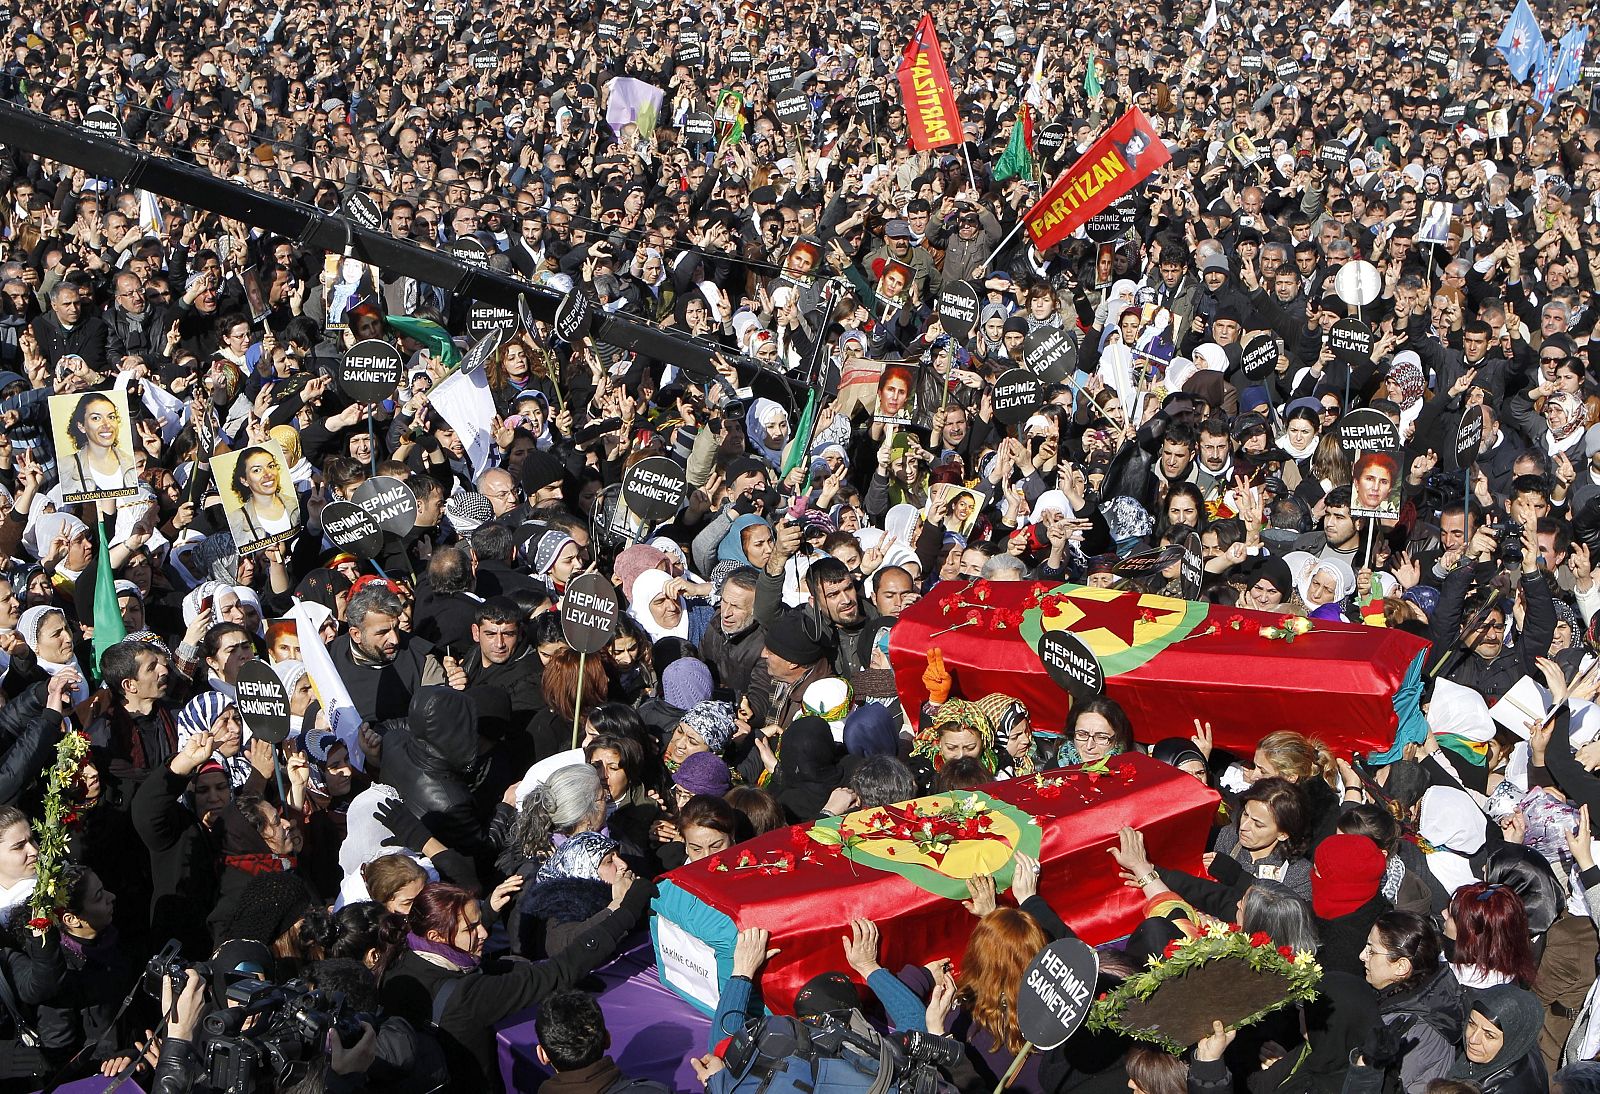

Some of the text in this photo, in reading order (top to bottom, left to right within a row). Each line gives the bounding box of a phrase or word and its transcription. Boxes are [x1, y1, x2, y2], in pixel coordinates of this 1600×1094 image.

[768, 66, 790, 76] HEPİMİZ
[776, 96, 806, 109] HEPİMİZ
[857, 90, 880, 100] HEPİMİZ
[777, 103, 808, 117] FİDAN'IZ
[83, 119, 117, 130] HEPİMİZ
[687, 119, 712, 128] HEPİMİZ
[1042, 131, 1064, 140] HEPİMİZ
[1323, 145, 1347, 156] HEPİMİZ
[1030, 151, 1125, 238] PARTİZAN
[351, 194, 379, 225] HEPİMİZ
[453, 249, 485, 261] HEPİMİZ
[559, 289, 584, 329] HEPİMİZ
[942, 292, 975, 310] HEPİMİZ
[471, 319, 514, 329] LEYLA'YIZ
[564, 295, 590, 338] FİDAN'IZ
[940, 307, 974, 323] SAKİNE'YİZ
[1332, 328, 1370, 343] HEPİMİZ
[1026, 331, 1064, 365] HEPİMİZ
[1242, 341, 1274, 365] HEPİMİZ
[1332, 339, 1368, 354] LEYLA'YIZ
[345, 355, 397, 370] HEPİMİZ
[1033, 342, 1072, 376] FİDAN'IZ
[1244, 349, 1277, 373] FİDAN'IZ
[343, 370, 397, 383] SAKİNE'YİZ
[995, 381, 1036, 398] HEPİMİZ
[995, 393, 1035, 409] LEYLA'YIZ
[1340, 422, 1392, 437] HEPİMİZ
[1459, 415, 1482, 440] HEPİMİZ
[1342, 436, 1395, 450] SAKİNE'YİZ
[633, 468, 685, 492] HEPİMİZ
[628, 480, 680, 506] SAKİNE'YİZ
[373, 499, 413, 523] DAN'IZ
[325, 510, 368, 534] HEPİMİZ
[334, 522, 378, 547] SAKİNE'YİZ
[569, 589, 614, 615] HEPİMİZ
[566, 607, 610, 632] LEYLA'YIZ
[1045, 638, 1096, 674] HEPİMİZ
[1043, 651, 1096, 689] FİDAN'IZ
[238, 681, 282, 698] HEPİMİZ
[240, 699, 287, 717] SAKİNE'YİZ
[662, 944, 710, 980] SAKİNE CANSIZ
[1041, 948, 1089, 1007] HEPİMİZ
[1026, 969, 1077, 1029] SAKİNE'YİZ
